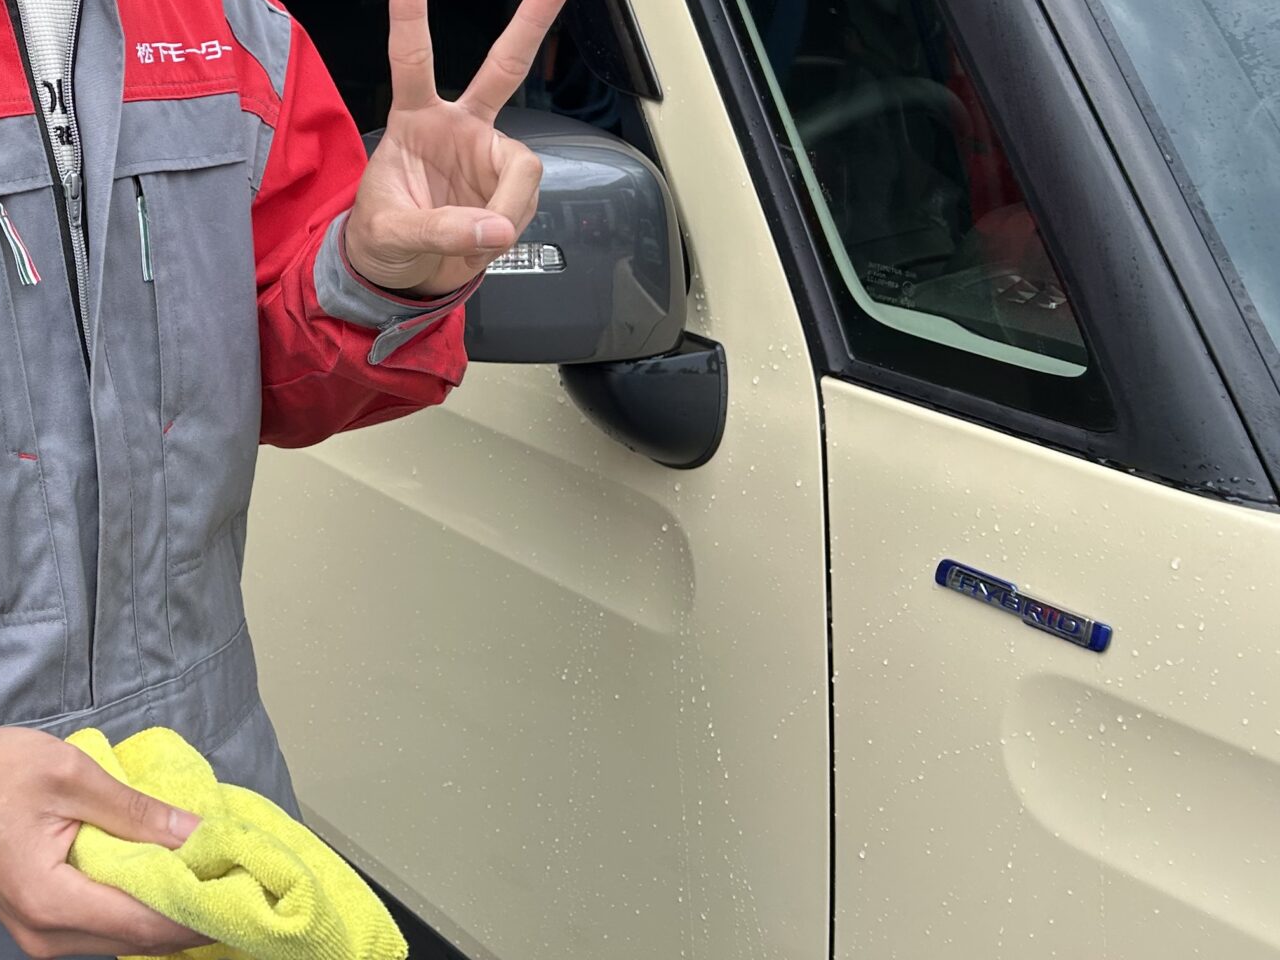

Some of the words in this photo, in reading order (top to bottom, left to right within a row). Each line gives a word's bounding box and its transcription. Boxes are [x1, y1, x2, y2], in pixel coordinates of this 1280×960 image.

[136, 40, 232, 64] 松下モーター
[959, 574, 1081, 634] HYBRID
